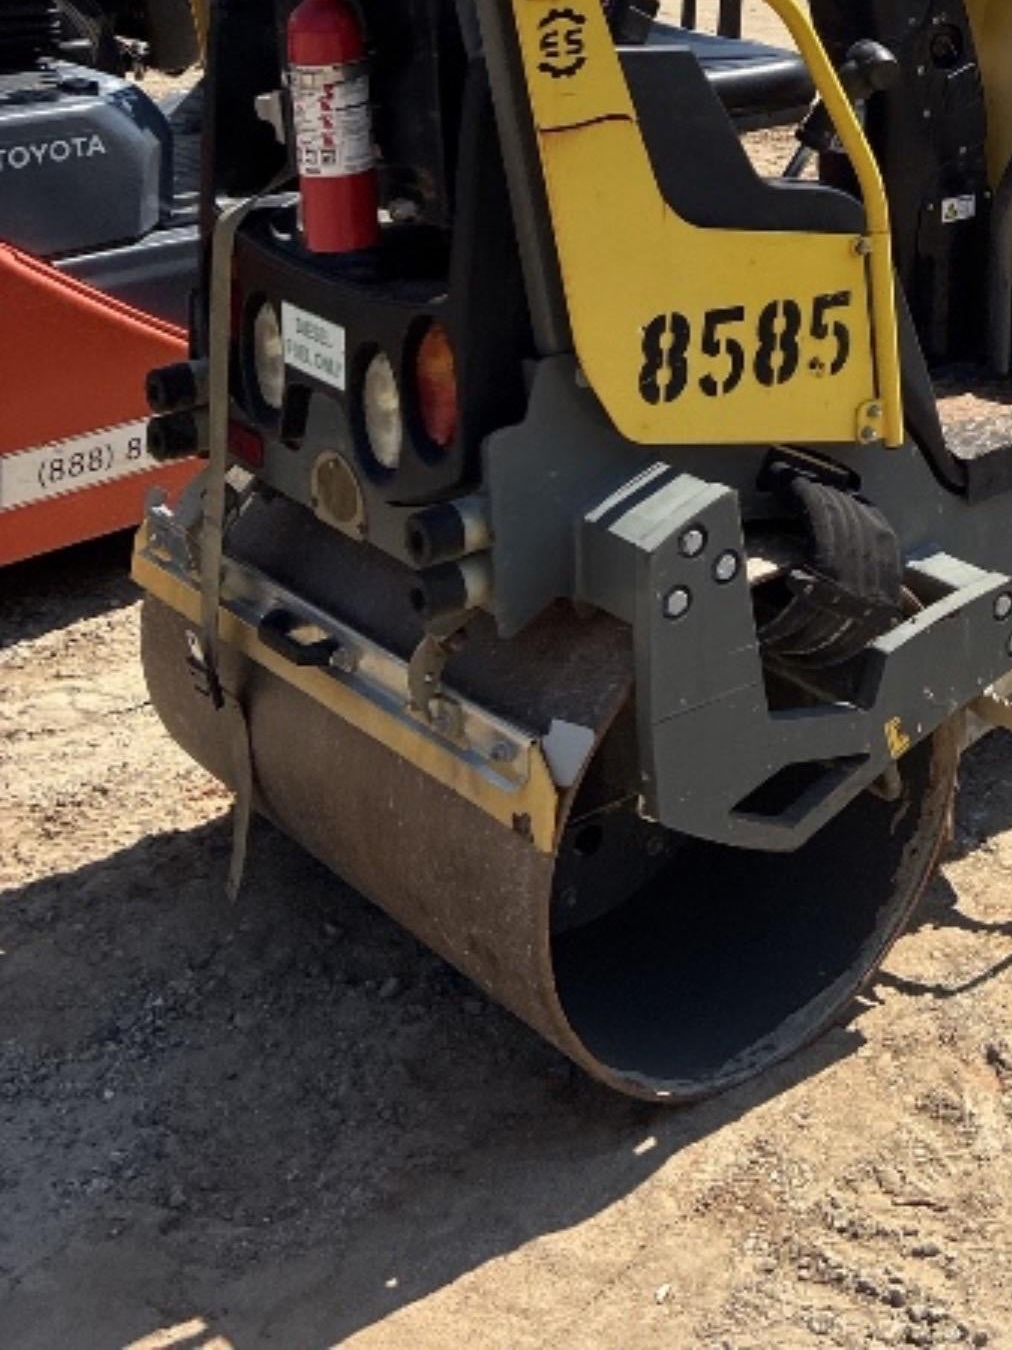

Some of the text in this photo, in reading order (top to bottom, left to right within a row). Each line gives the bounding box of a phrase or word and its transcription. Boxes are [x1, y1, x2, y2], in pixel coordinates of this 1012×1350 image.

[638, 289, 852, 406] 8585
[37, 437, 143, 488] (888) 8
